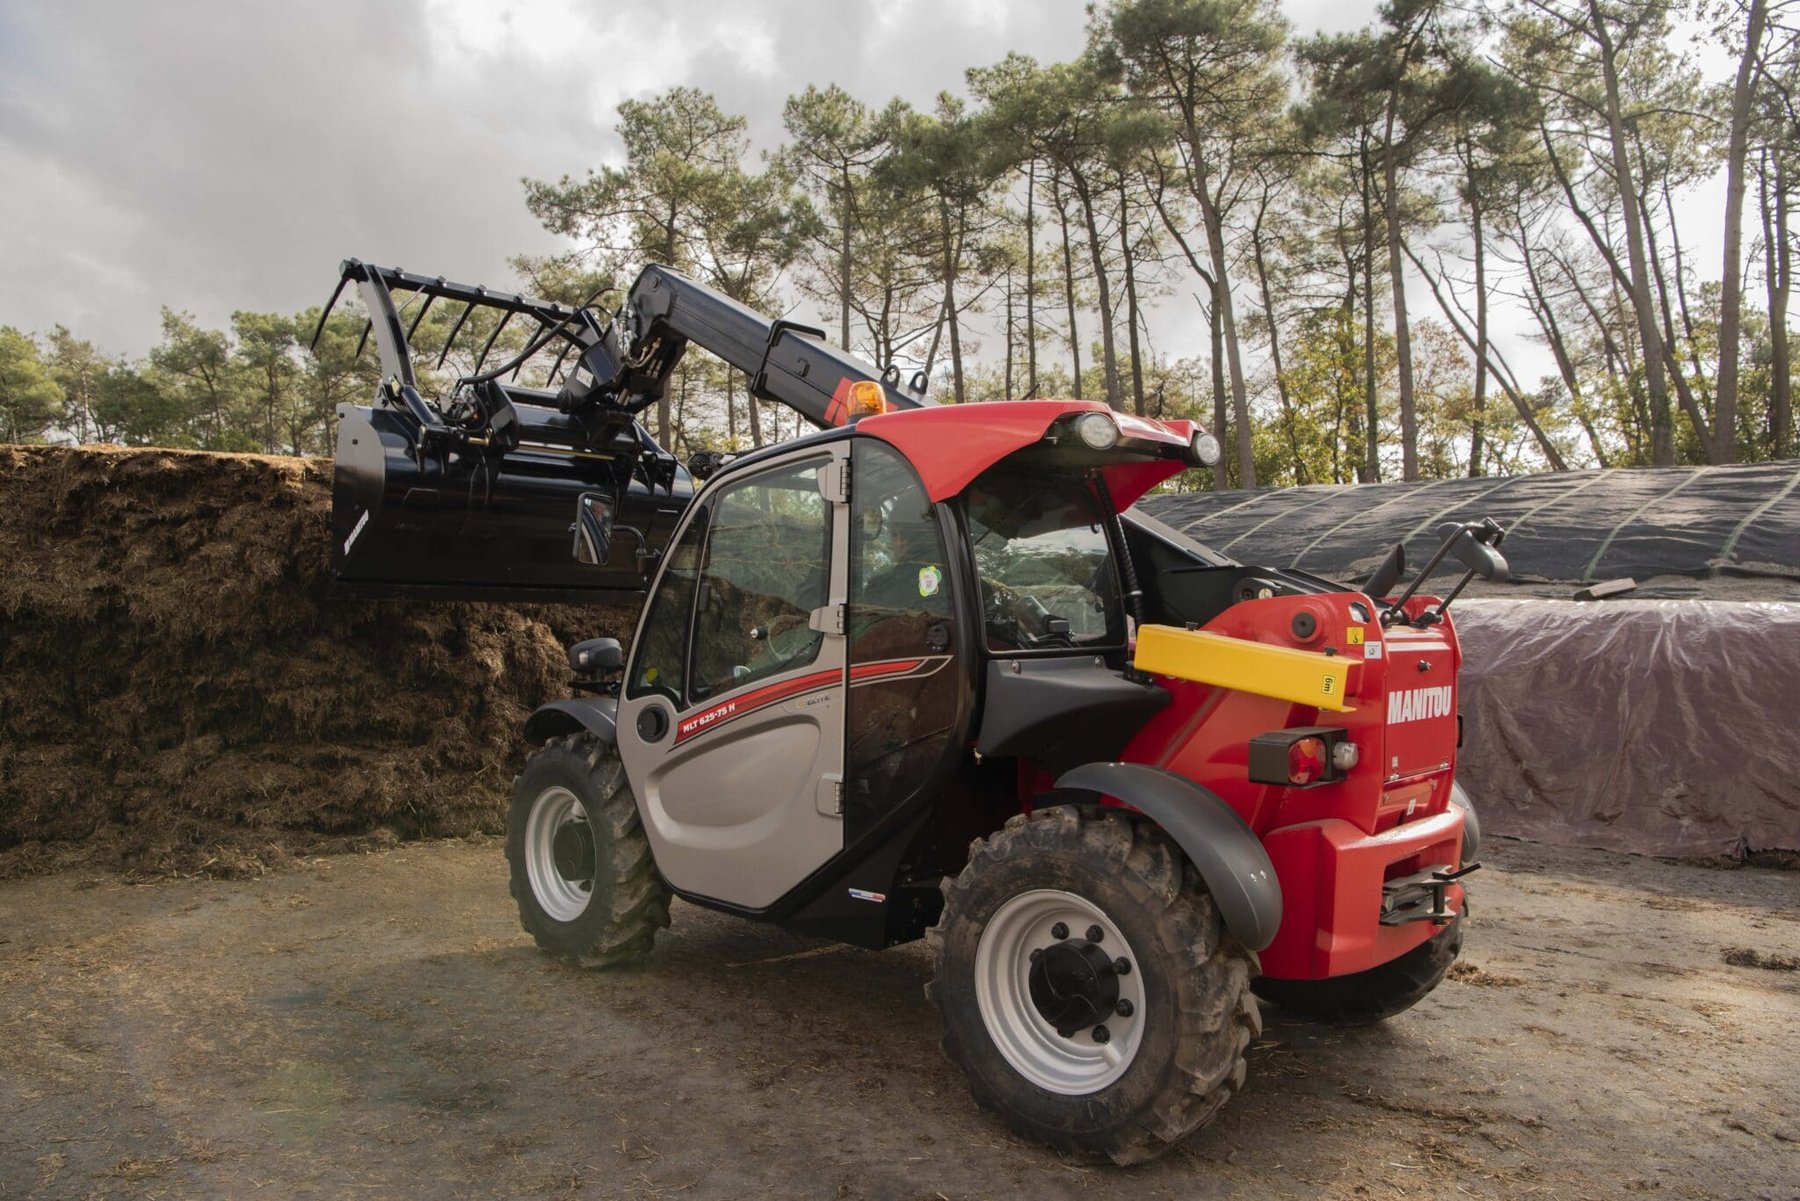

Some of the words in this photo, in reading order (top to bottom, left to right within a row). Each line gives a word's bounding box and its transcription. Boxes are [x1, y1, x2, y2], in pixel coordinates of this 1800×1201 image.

[1323, 677, 1333, 692] 6m
[683, 719, 698, 733] MLT
[699, 706, 728, 725] 625-75
[728, 703, 736, 712] H
[1387, 685, 1452, 725] MANITOU
